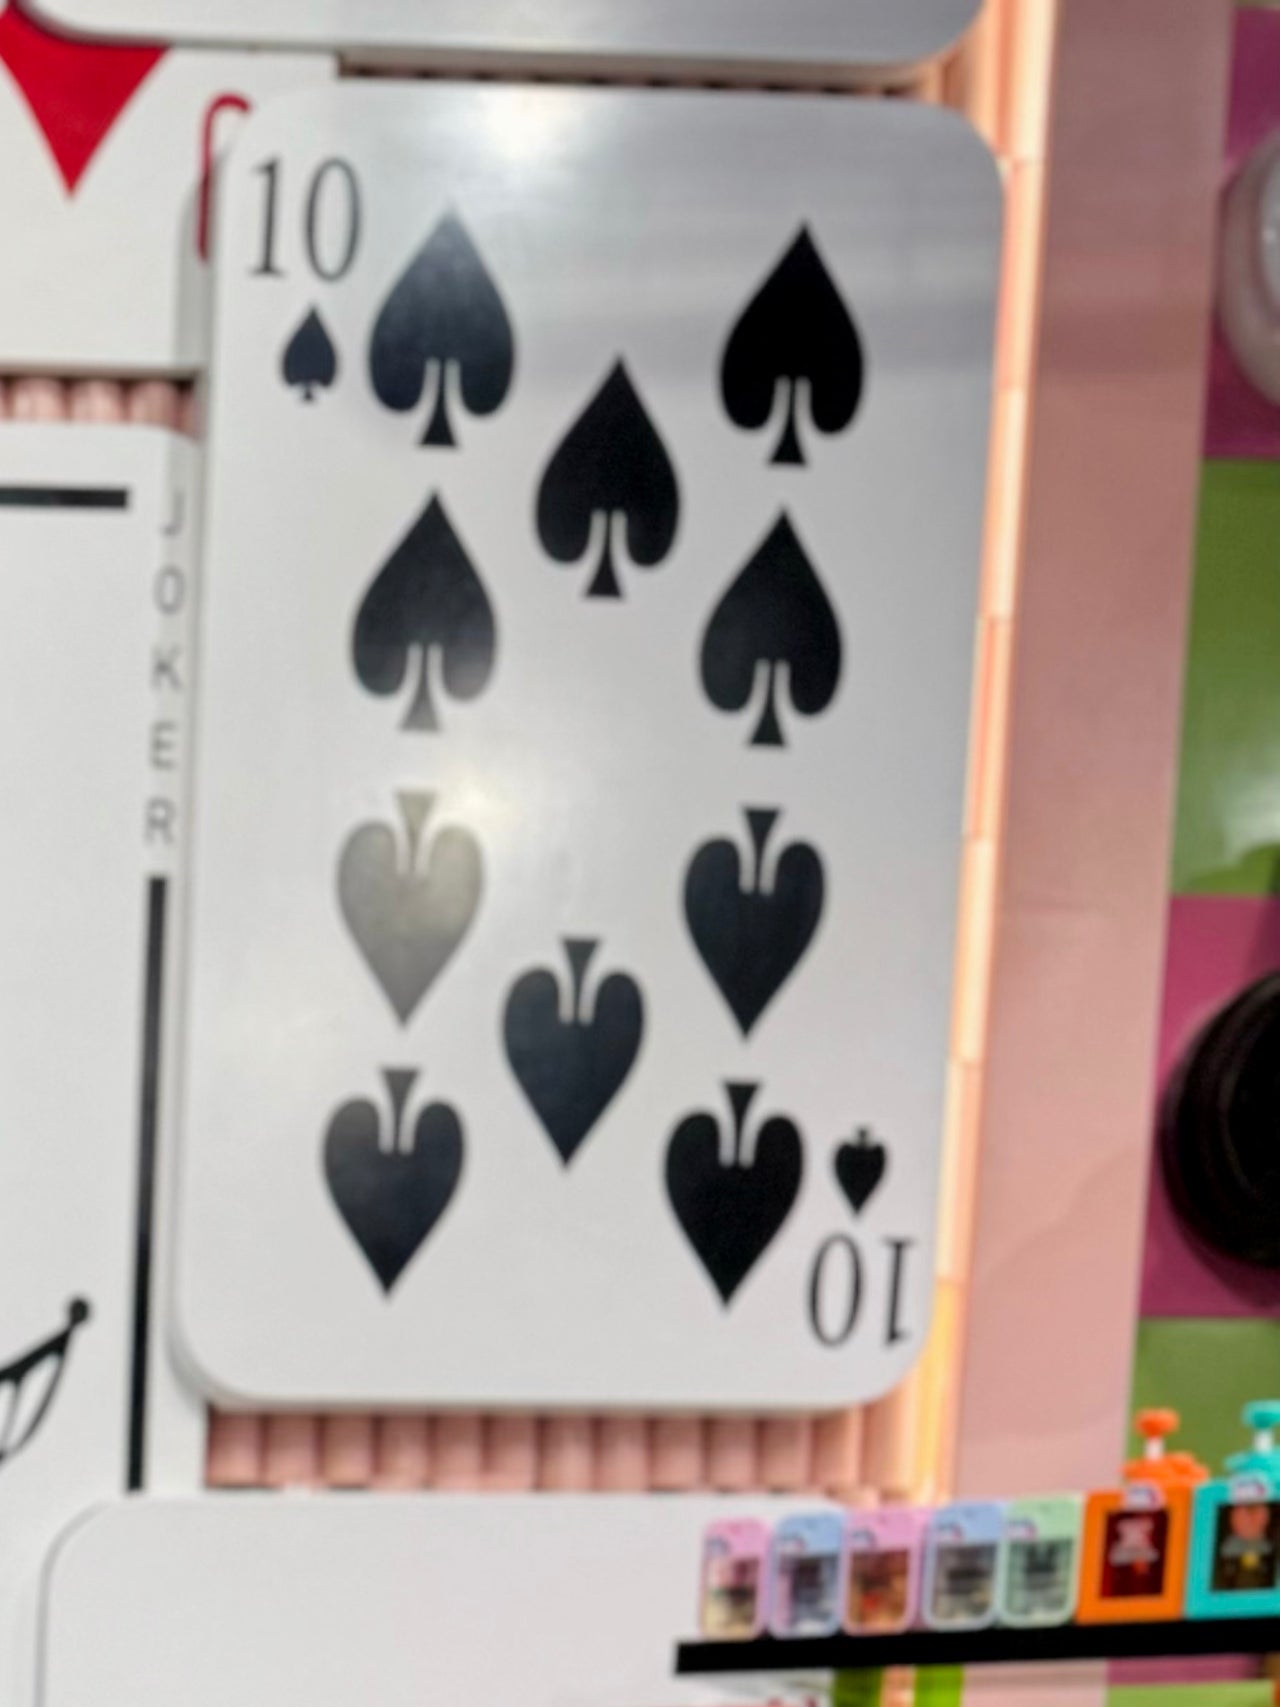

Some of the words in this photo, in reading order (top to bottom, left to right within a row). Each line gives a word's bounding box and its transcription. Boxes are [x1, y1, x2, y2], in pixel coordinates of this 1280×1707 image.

[250, 154, 362, 283] 10
[144, 488, 187, 846] JOKER
[806, 1233, 919, 1351] 10
